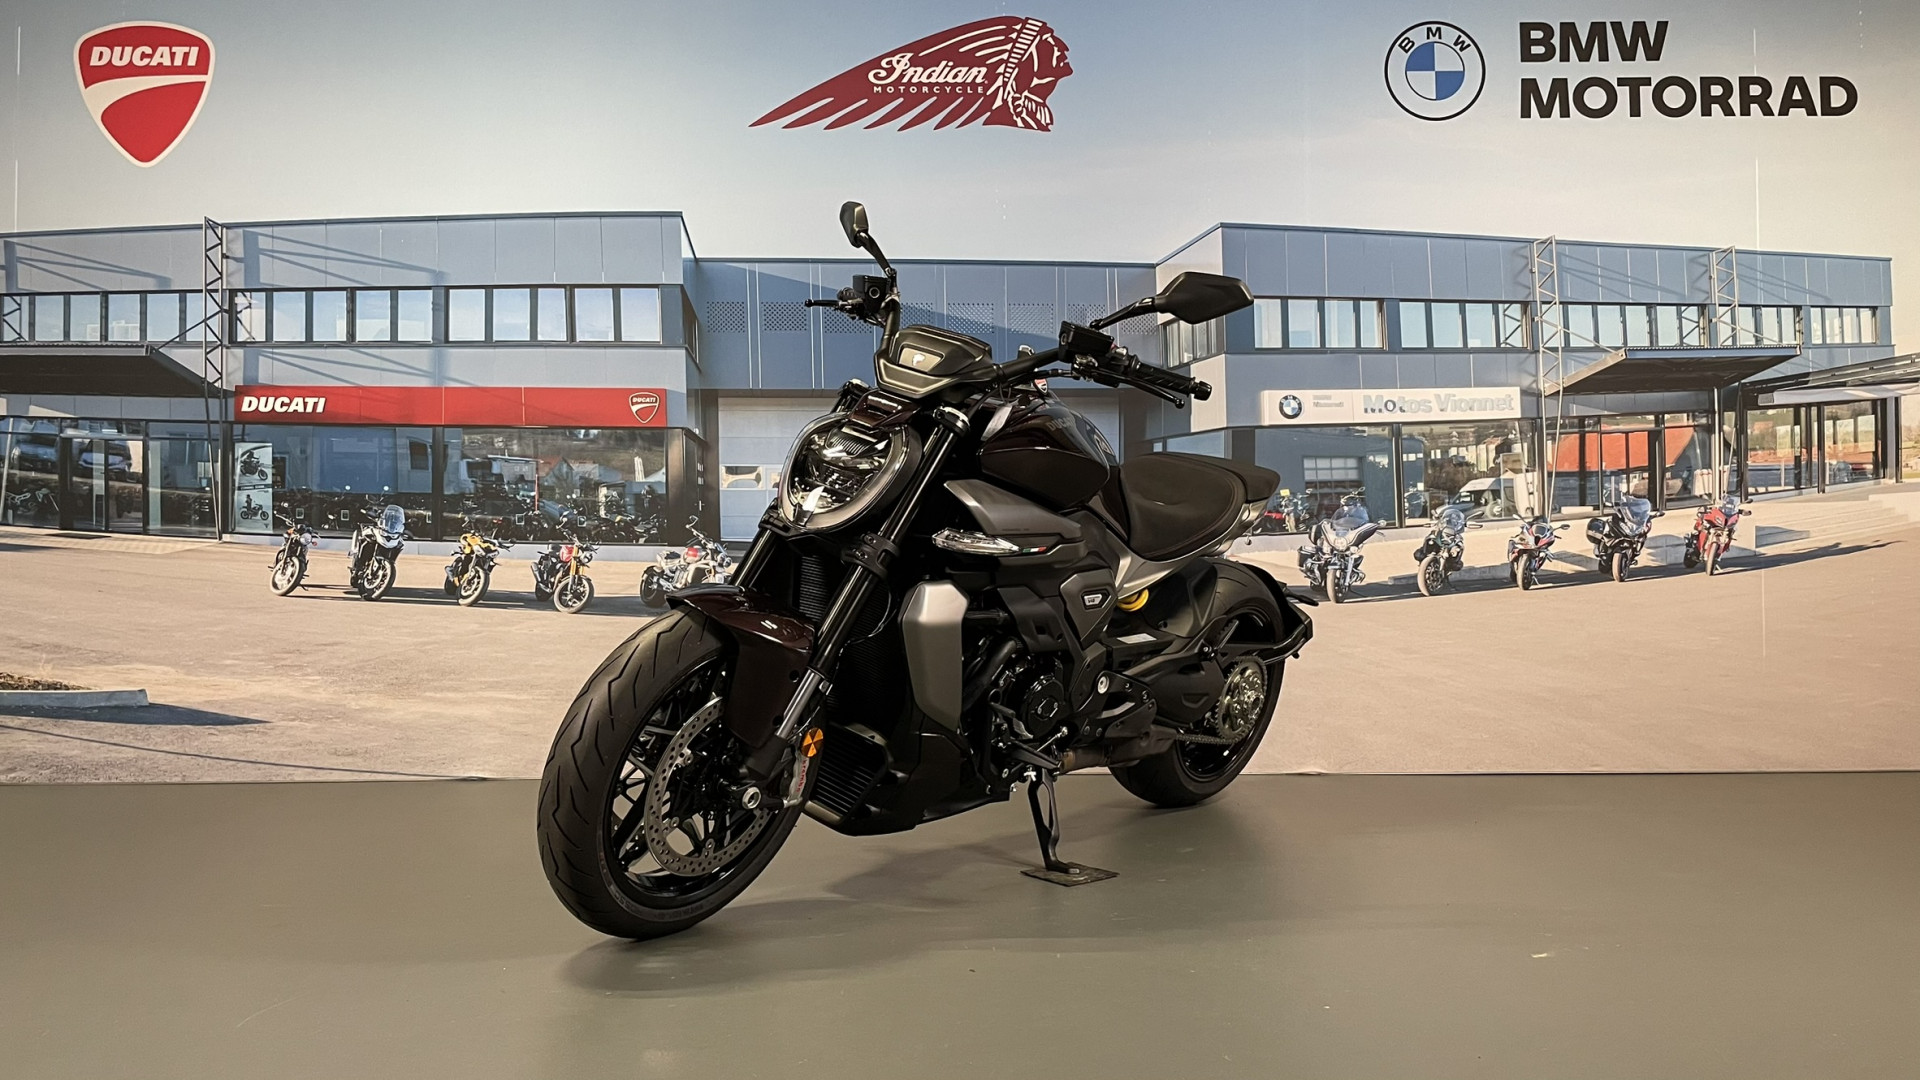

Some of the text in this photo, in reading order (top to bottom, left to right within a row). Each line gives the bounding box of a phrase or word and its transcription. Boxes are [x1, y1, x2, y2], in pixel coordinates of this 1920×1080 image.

[1397, 26, 1471, 54] BMW
[1519, 21, 1669, 62] BMW
[89, 45, 200, 67] DUCATI
[868, 53, 987, 84] Indian
[873, 86, 984, 94] MOTORCYCLE
[1520, 76, 1858, 118] MOTORRAD
[241, 396, 326, 413] DUCATI
[1363, 393, 1514, 414] Motos Vionnet
